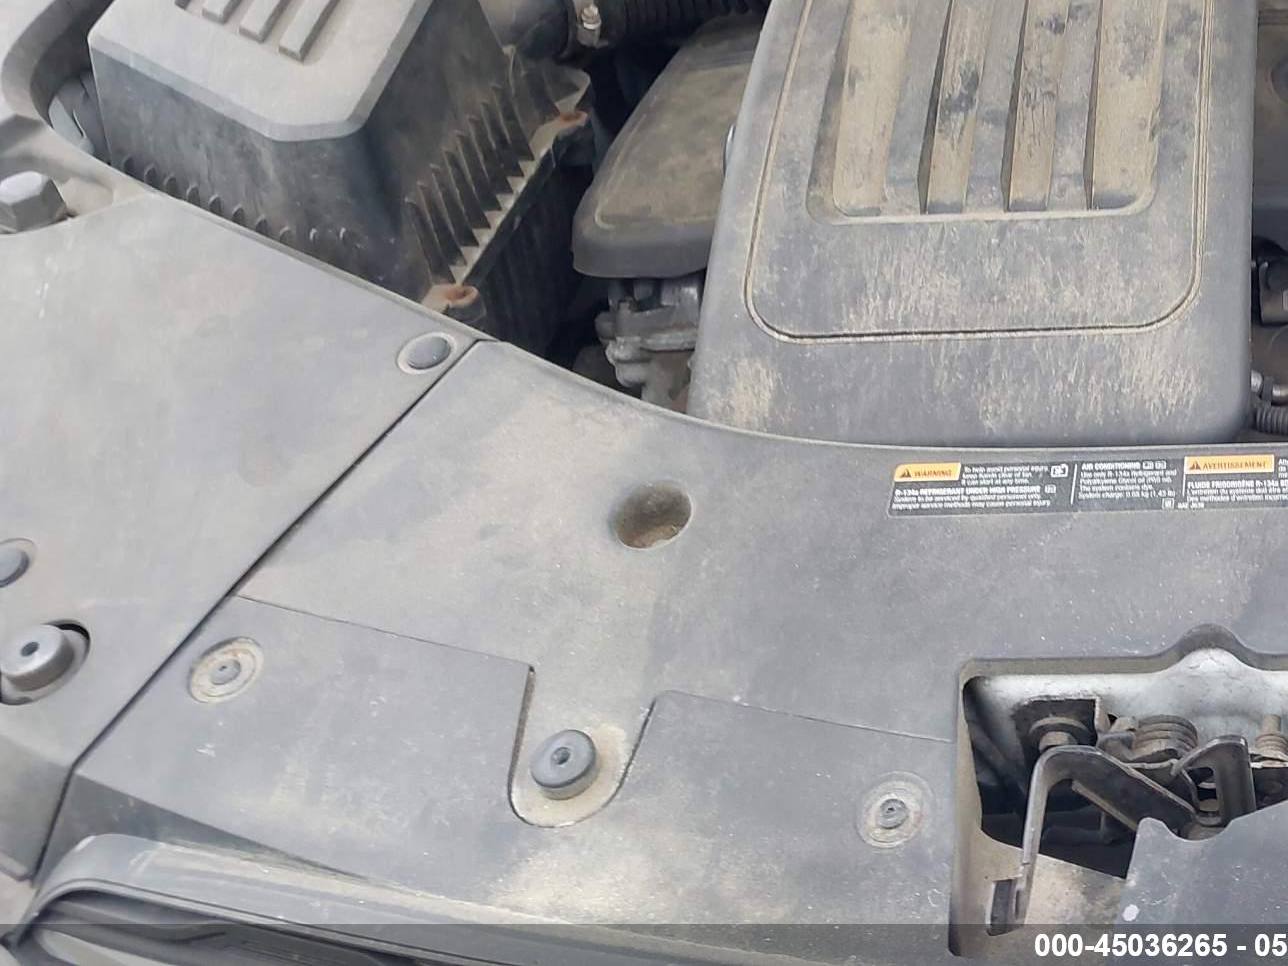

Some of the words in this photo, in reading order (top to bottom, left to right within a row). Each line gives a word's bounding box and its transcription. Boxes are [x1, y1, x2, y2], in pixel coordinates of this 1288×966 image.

[1095, 462, 1140, 470] CONDITIONING
[1203, 462, 1267, 470] AVERTISSEMENT
[1188, 481, 1210, 489] FLUIDE
[920, 487, 964, 496] REFRIGERANT
[966, 487, 988, 495] UNDER
[1007, 486, 1041, 494] PRESSURE
